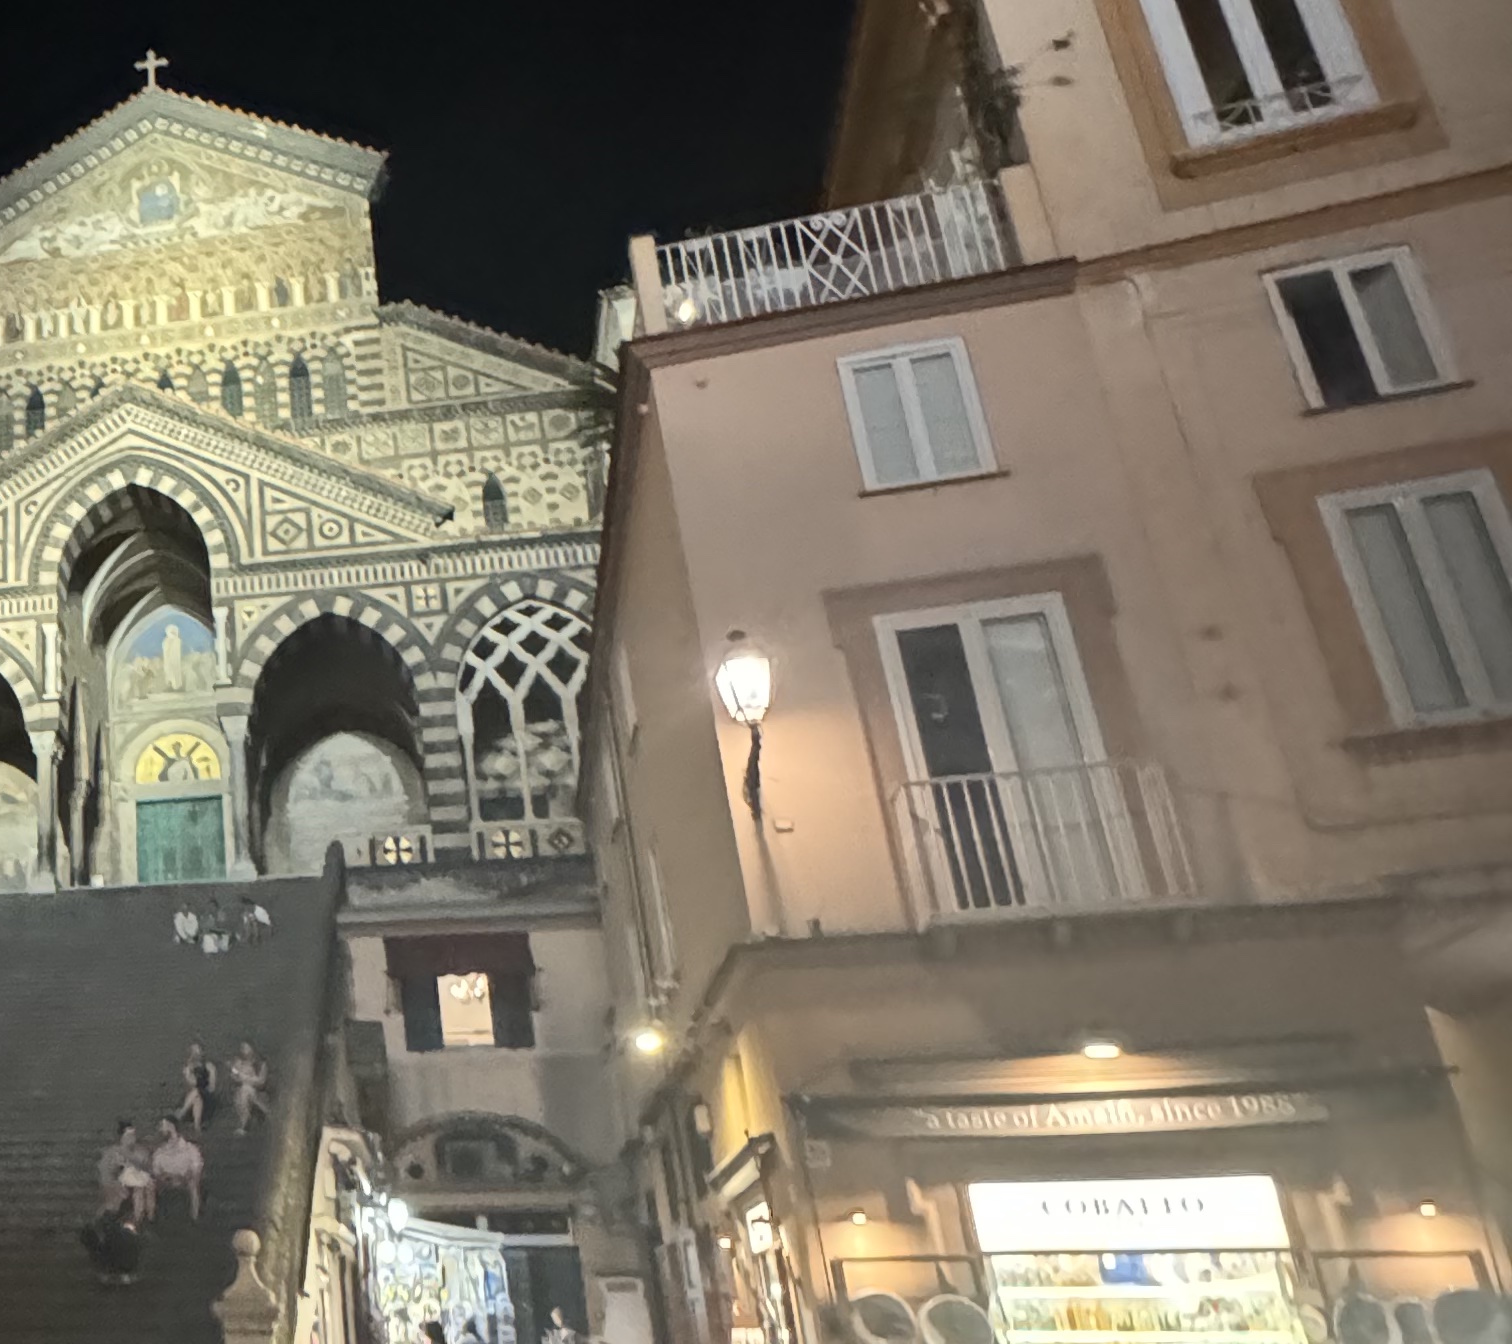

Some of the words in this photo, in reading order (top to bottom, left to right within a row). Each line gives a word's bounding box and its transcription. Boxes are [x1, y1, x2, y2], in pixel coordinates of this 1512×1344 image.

[946, 1108, 1007, 1130] taste
[1013, 1105, 1038, 1129] of
[1150, 1097, 1221, 1123] since
